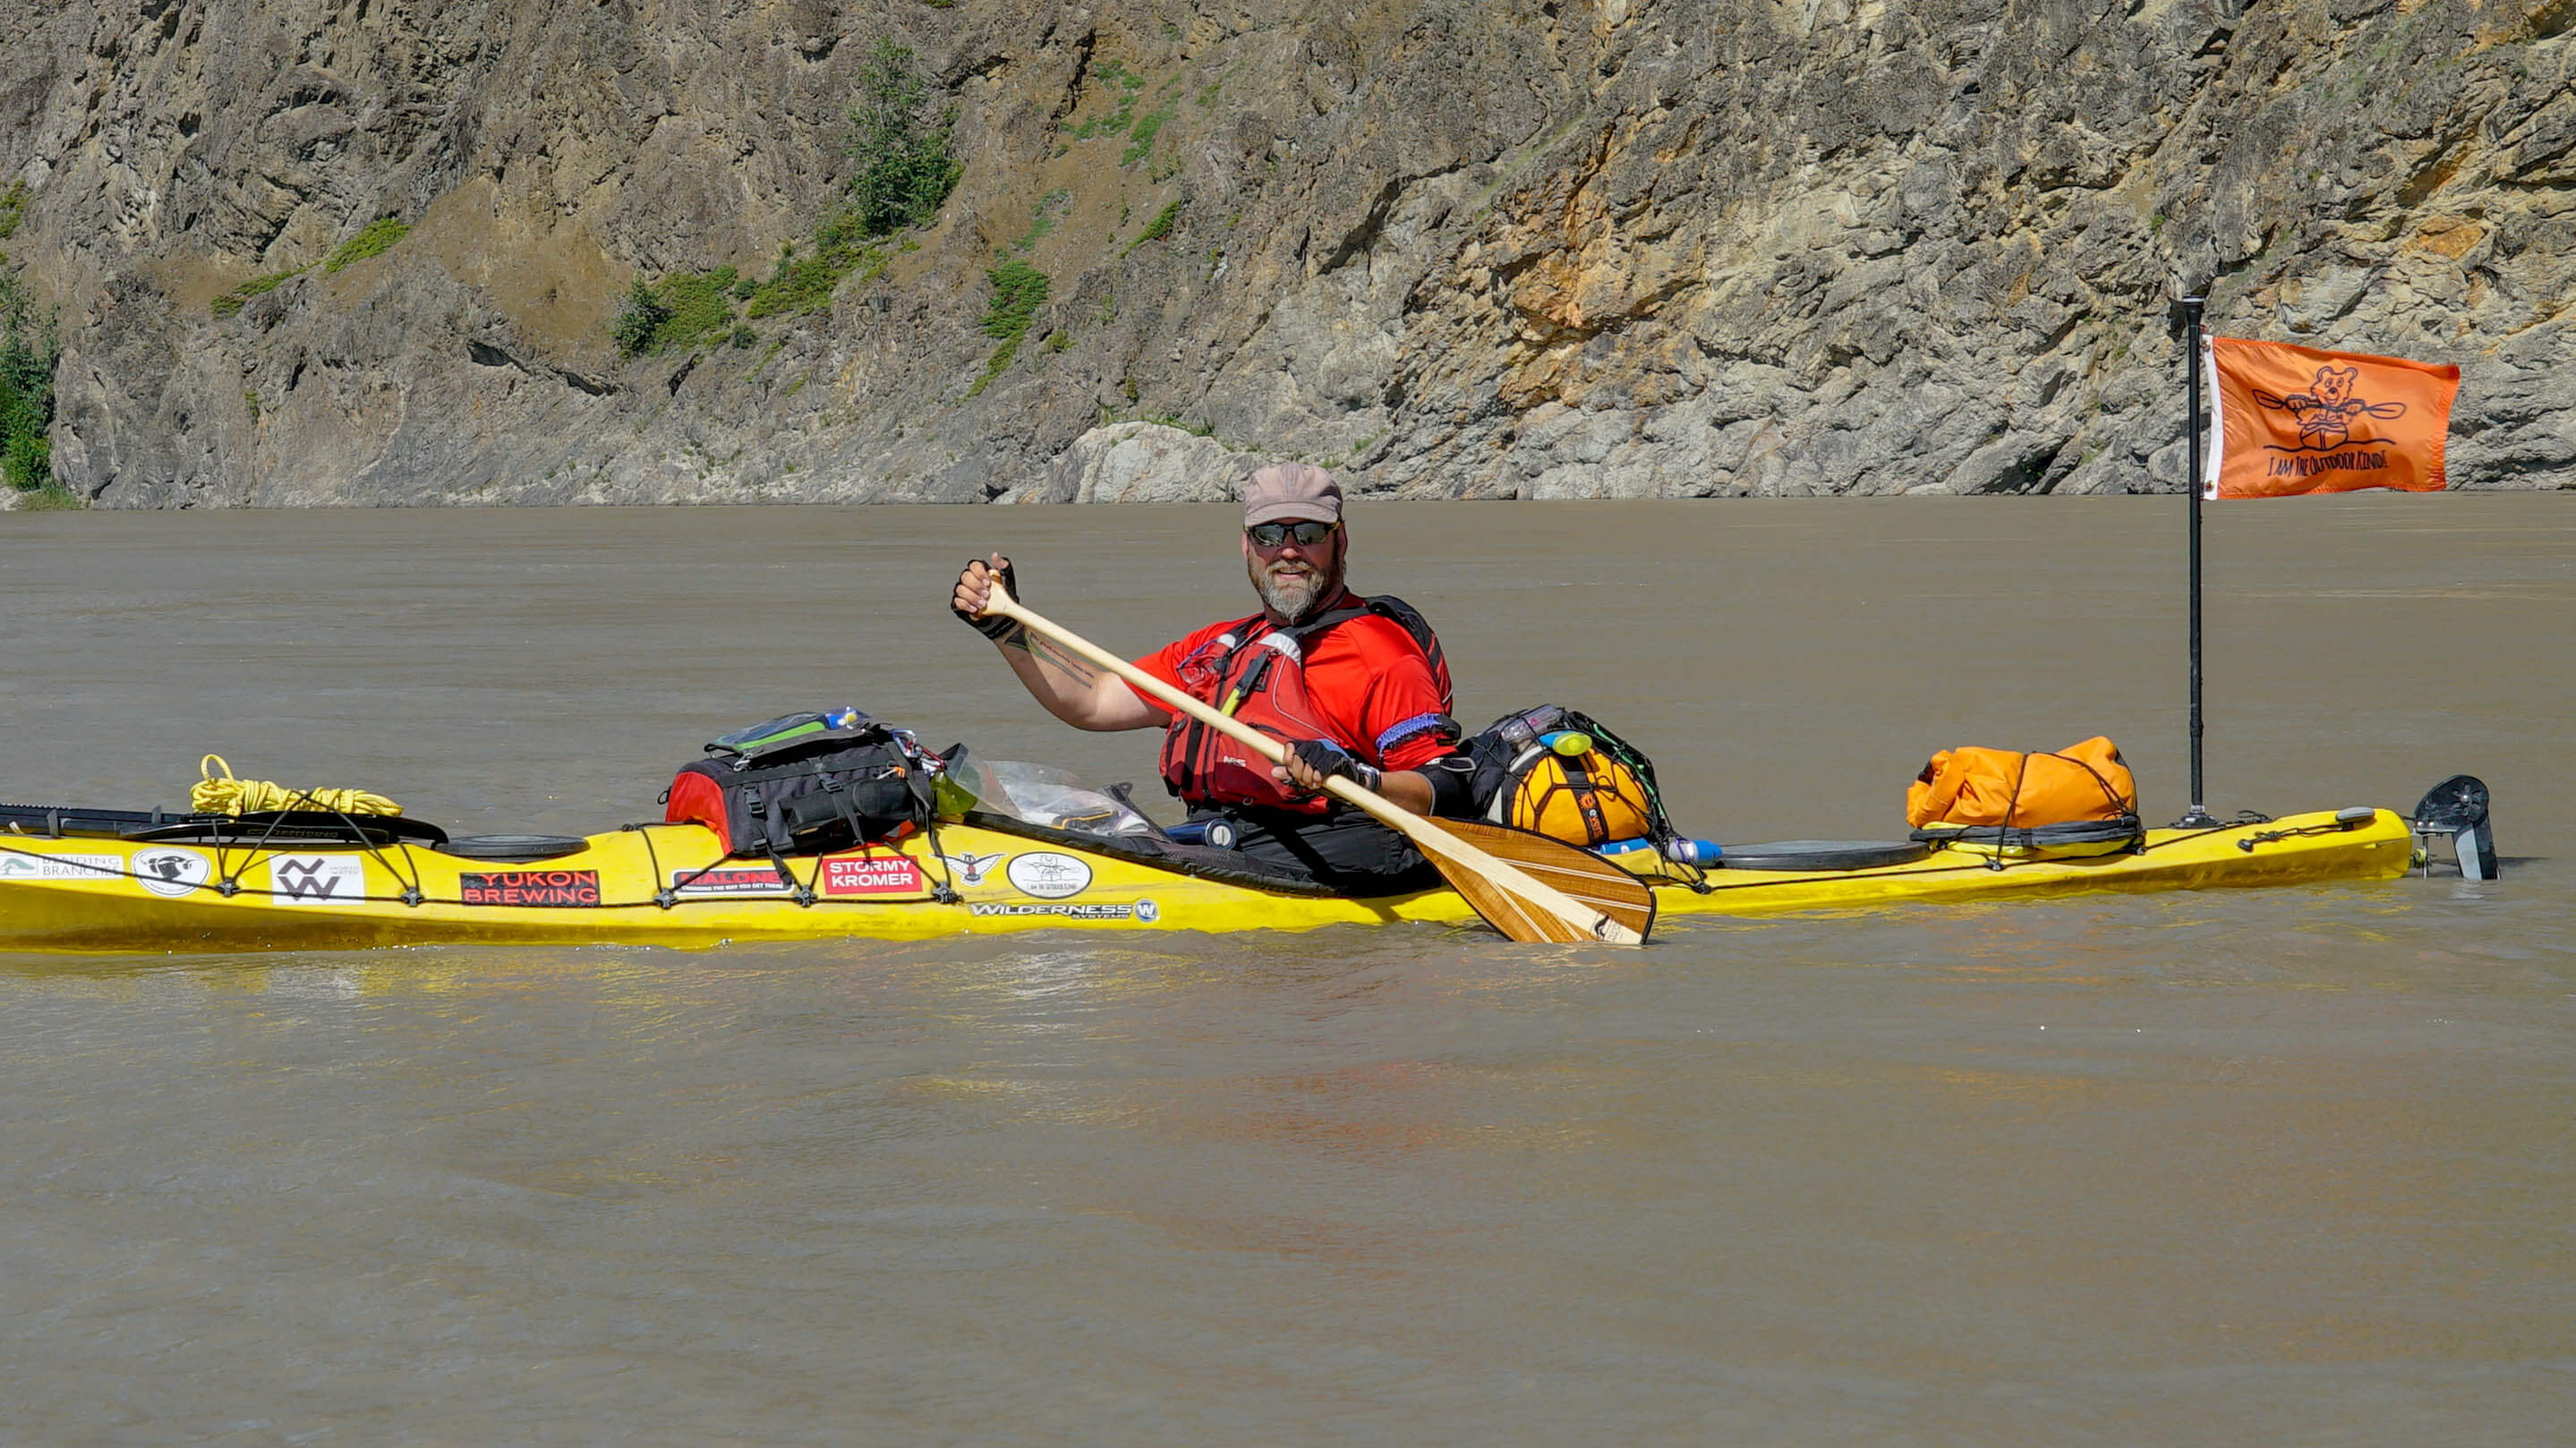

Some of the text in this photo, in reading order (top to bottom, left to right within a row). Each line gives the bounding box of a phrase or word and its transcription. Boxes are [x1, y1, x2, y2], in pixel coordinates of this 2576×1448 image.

[2266, 456, 2275, 476] I
[2275, 457, 2294, 477] AM
[2295, 456, 2308, 476] THE
[829, 860, 911, 873] STORMY
[479, 871, 597, 887] YUKON
[831, 873, 914, 888] KROMER
[465, 887, 599, 904] BREWING
[970, 903, 1132, 916] WILDERNESS
